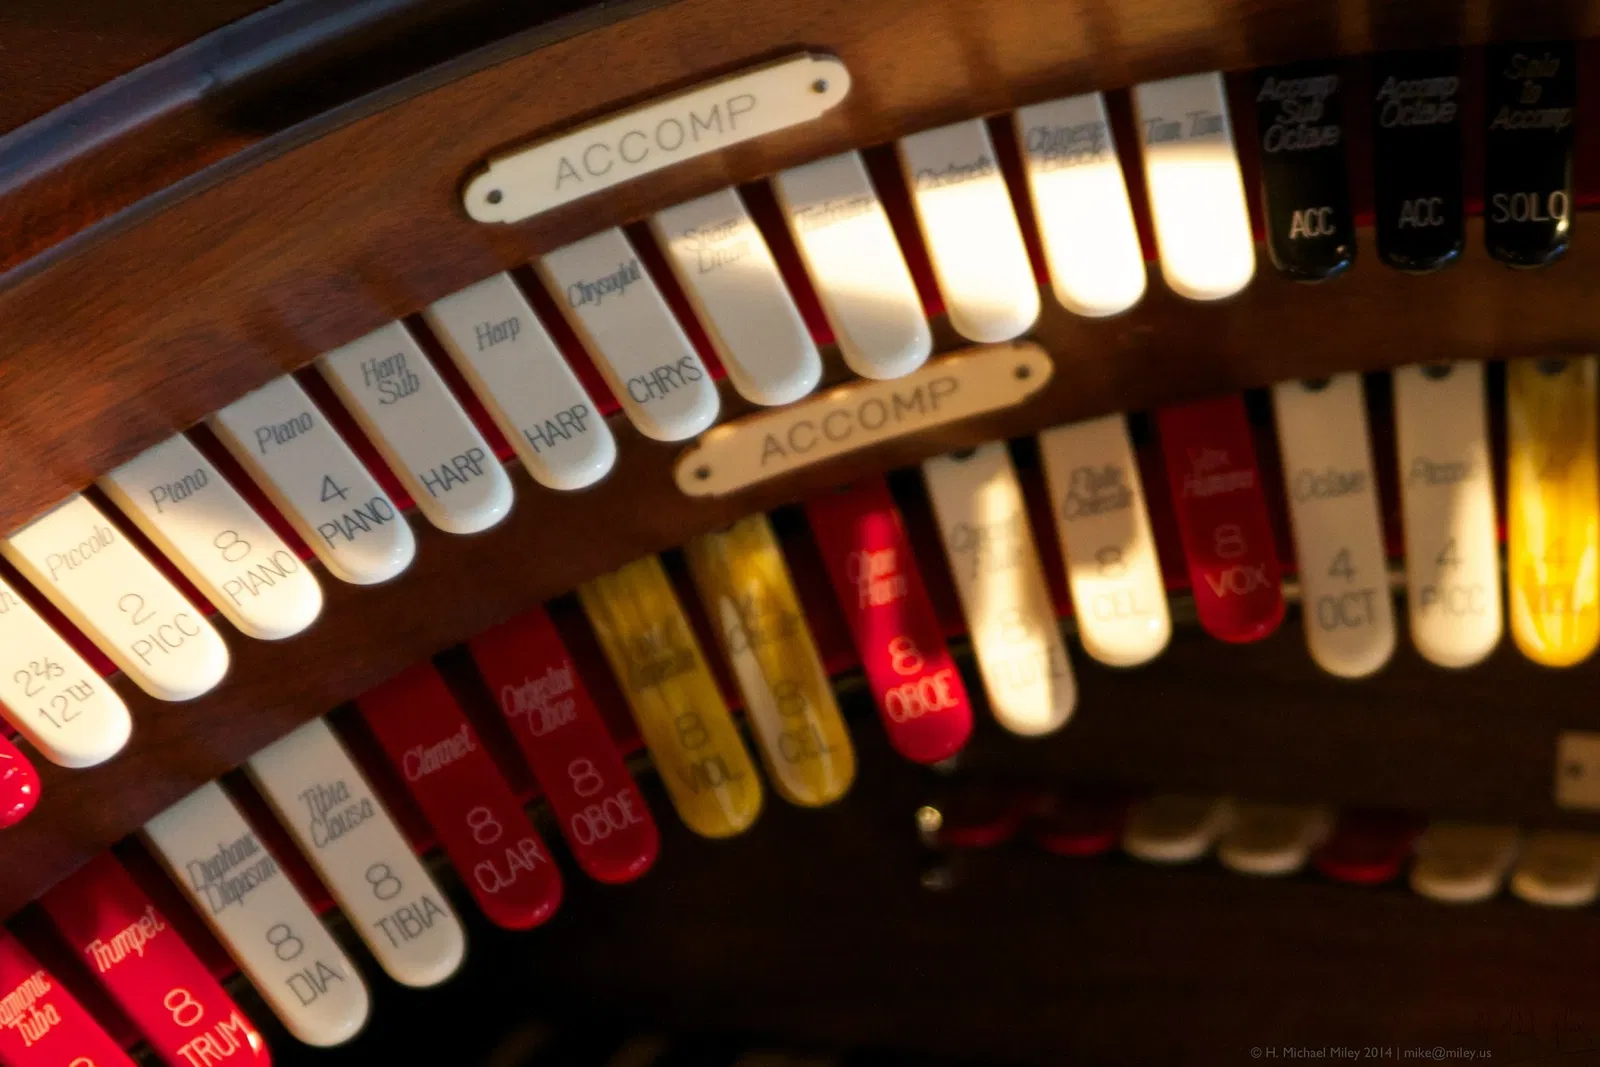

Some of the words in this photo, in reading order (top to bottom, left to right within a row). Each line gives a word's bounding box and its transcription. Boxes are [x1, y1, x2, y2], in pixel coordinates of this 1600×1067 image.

[1277, 98, 1325, 125] Sub
[1380, 100, 1458, 128] Octave
[555, 93, 758, 192] ACCOMP
[1263, 123, 1341, 153] Octave
[1289, 206, 1336, 240] ACC
[1398, 196, 1445, 229] ACC
[1491, 189, 1569, 224] SOLO
[474, 315, 521, 352] Harp
[361, 352, 408, 388] Harp
[376, 369, 421, 406] Sub
[627, 356, 704, 405] CHRYS
[253, 411, 314, 455] Piano
[522, 403, 590, 455] HARP
[760, 375, 959, 468] ACCOMP
[149, 468, 210, 514] Piano
[319, 474, 351, 504] 4
[419, 447, 487, 498] HARP
[316, 495, 397, 550] PIANO
[1213, 521, 1249, 561] 8
[43, 525, 116, 582] Piccolo
[212, 529, 253, 563] 8
[1327, 546, 1357, 582] 4
[222, 549, 300, 607] PIANO
[1201, 561, 1273, 600] VOX
[116, 592, 157, 627] 2
[1316, 587, 1378, 632] OCT
[131, 612, 201, 666] PICC
[887, 636, 925, 676] 8
[885, 667, 961, 724] OBOE
[675, 710, 709, 751] 8
[566, 756, 605, 798] 8
[298, 780, 352, 824] Tibia
[569, 787, 645, 847] OBOE
[466, 805, 503, 845] 8
[364, 862, 403, 902] 8
[473, 837, 547, 894] CLAR
[84, 904, 166, 974] Trumpet
[265, 922, 305, 962] 8
[372, 894, 448, 949] TIBIA
[284, 960, 345, 1008] DIA
[8, 1003, 61, 1047] Tuba
[162, 987, 205, 1027] 8
[176, 1009, 252, 1067] TRUM
